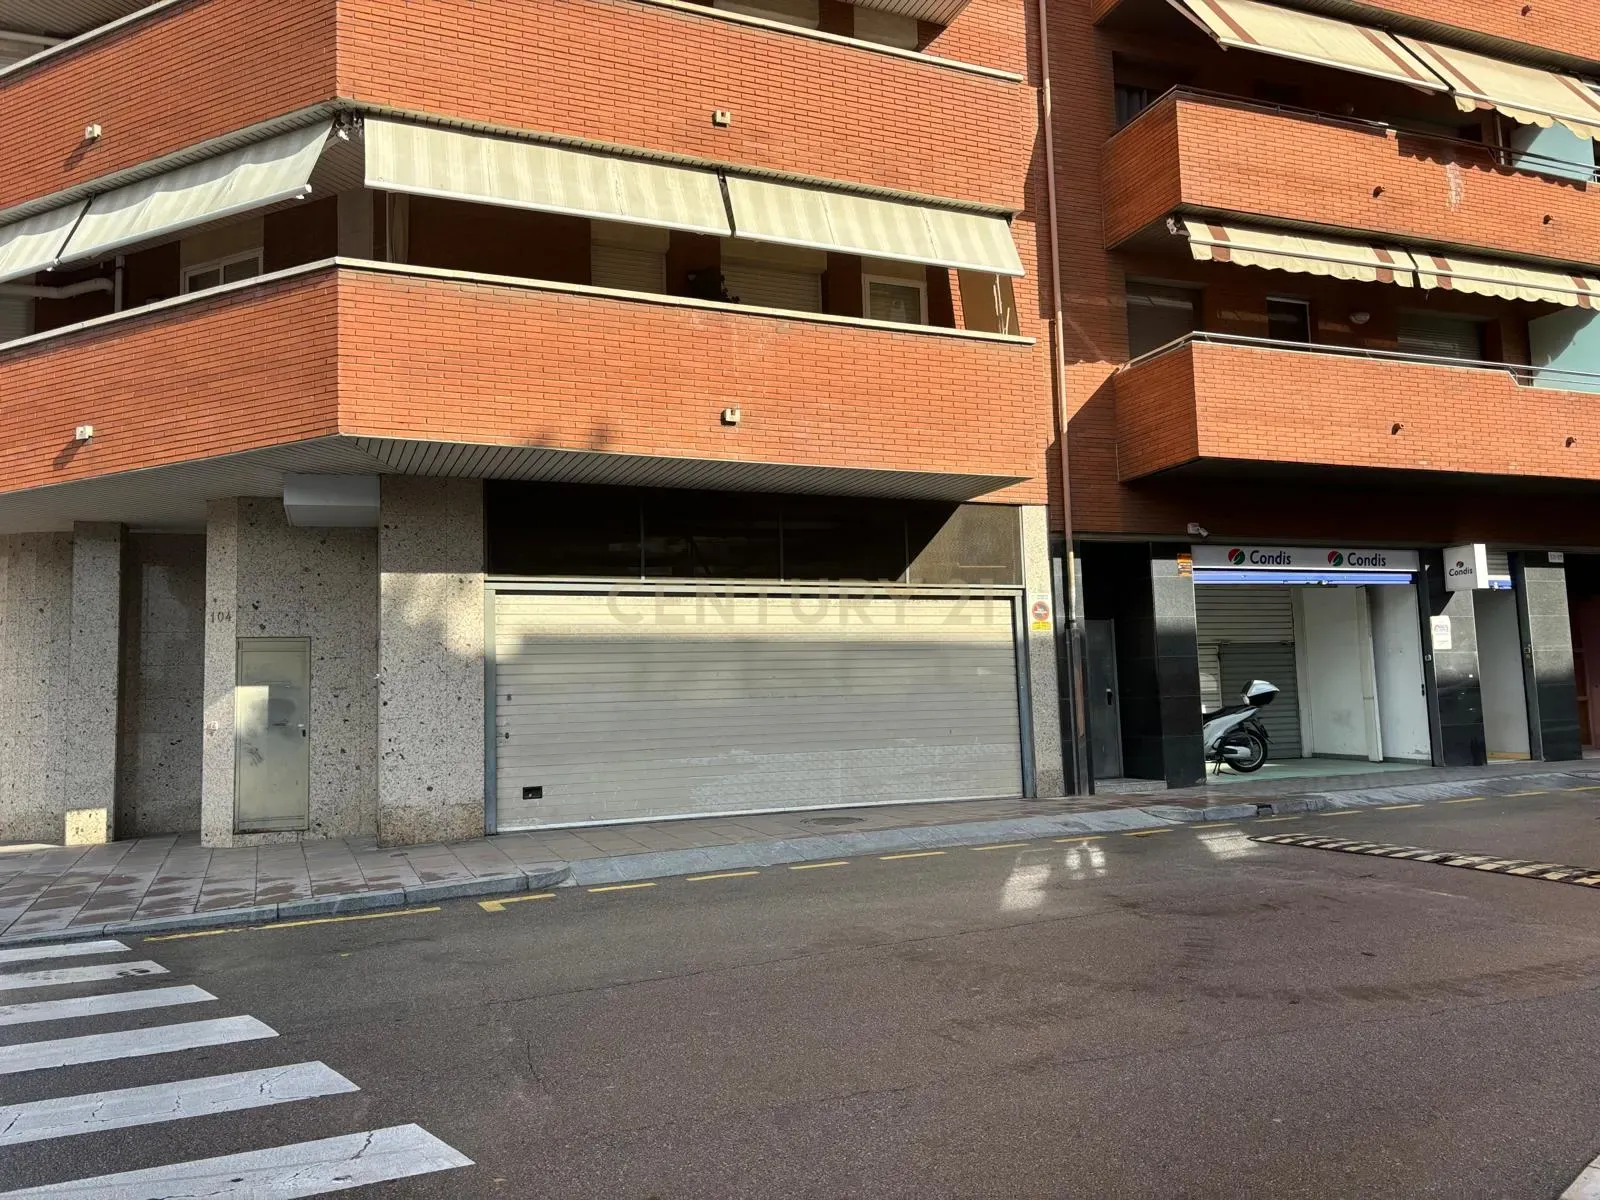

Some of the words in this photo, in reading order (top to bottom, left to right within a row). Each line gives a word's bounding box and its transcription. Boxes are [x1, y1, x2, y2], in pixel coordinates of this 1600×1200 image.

[1249, 550, 1292, 565] Condis
[1347, 552, 1387, 567] Condis
[1448, 565, 1473, 577] Condis
[210, 611, 232, 623] 104
